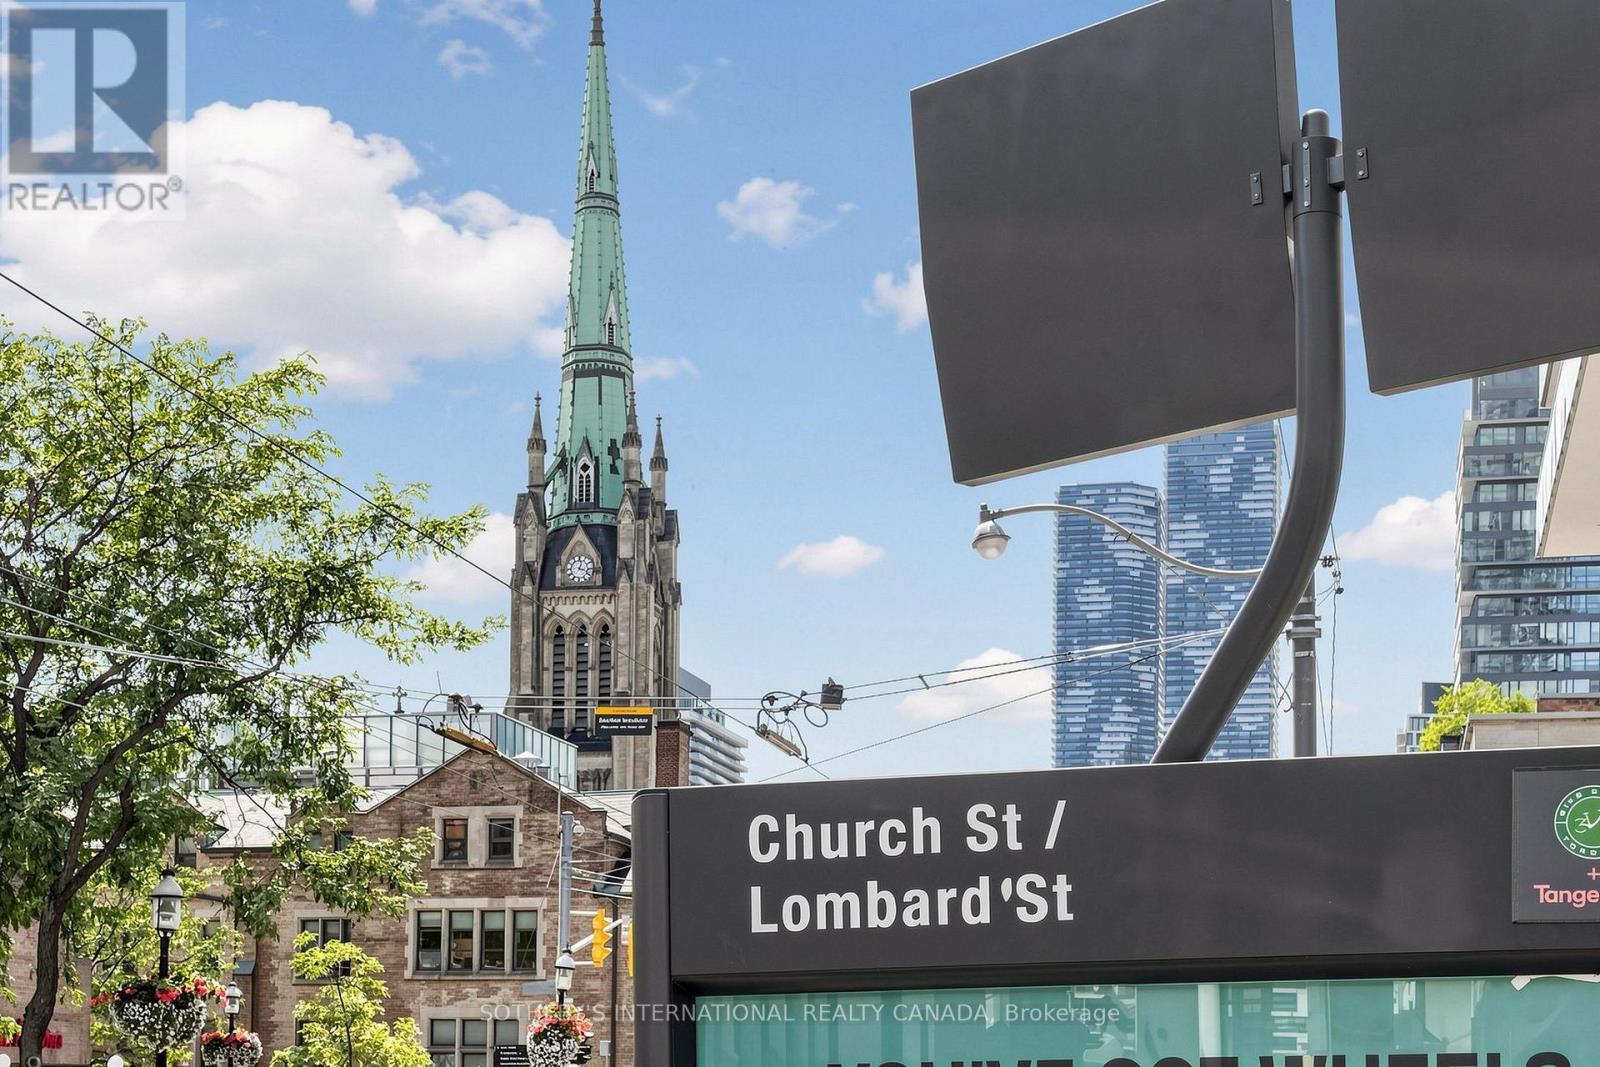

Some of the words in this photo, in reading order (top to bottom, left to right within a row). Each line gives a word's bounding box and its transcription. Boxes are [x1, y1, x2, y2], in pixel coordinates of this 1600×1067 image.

[748, 807, 942, 863] Church
[966, 803, 1023, 852] St
[1045, 800, 1067, 849] /
[750, 876, 991, 933] Lombard
[1015, 873, 1074, 923] St
